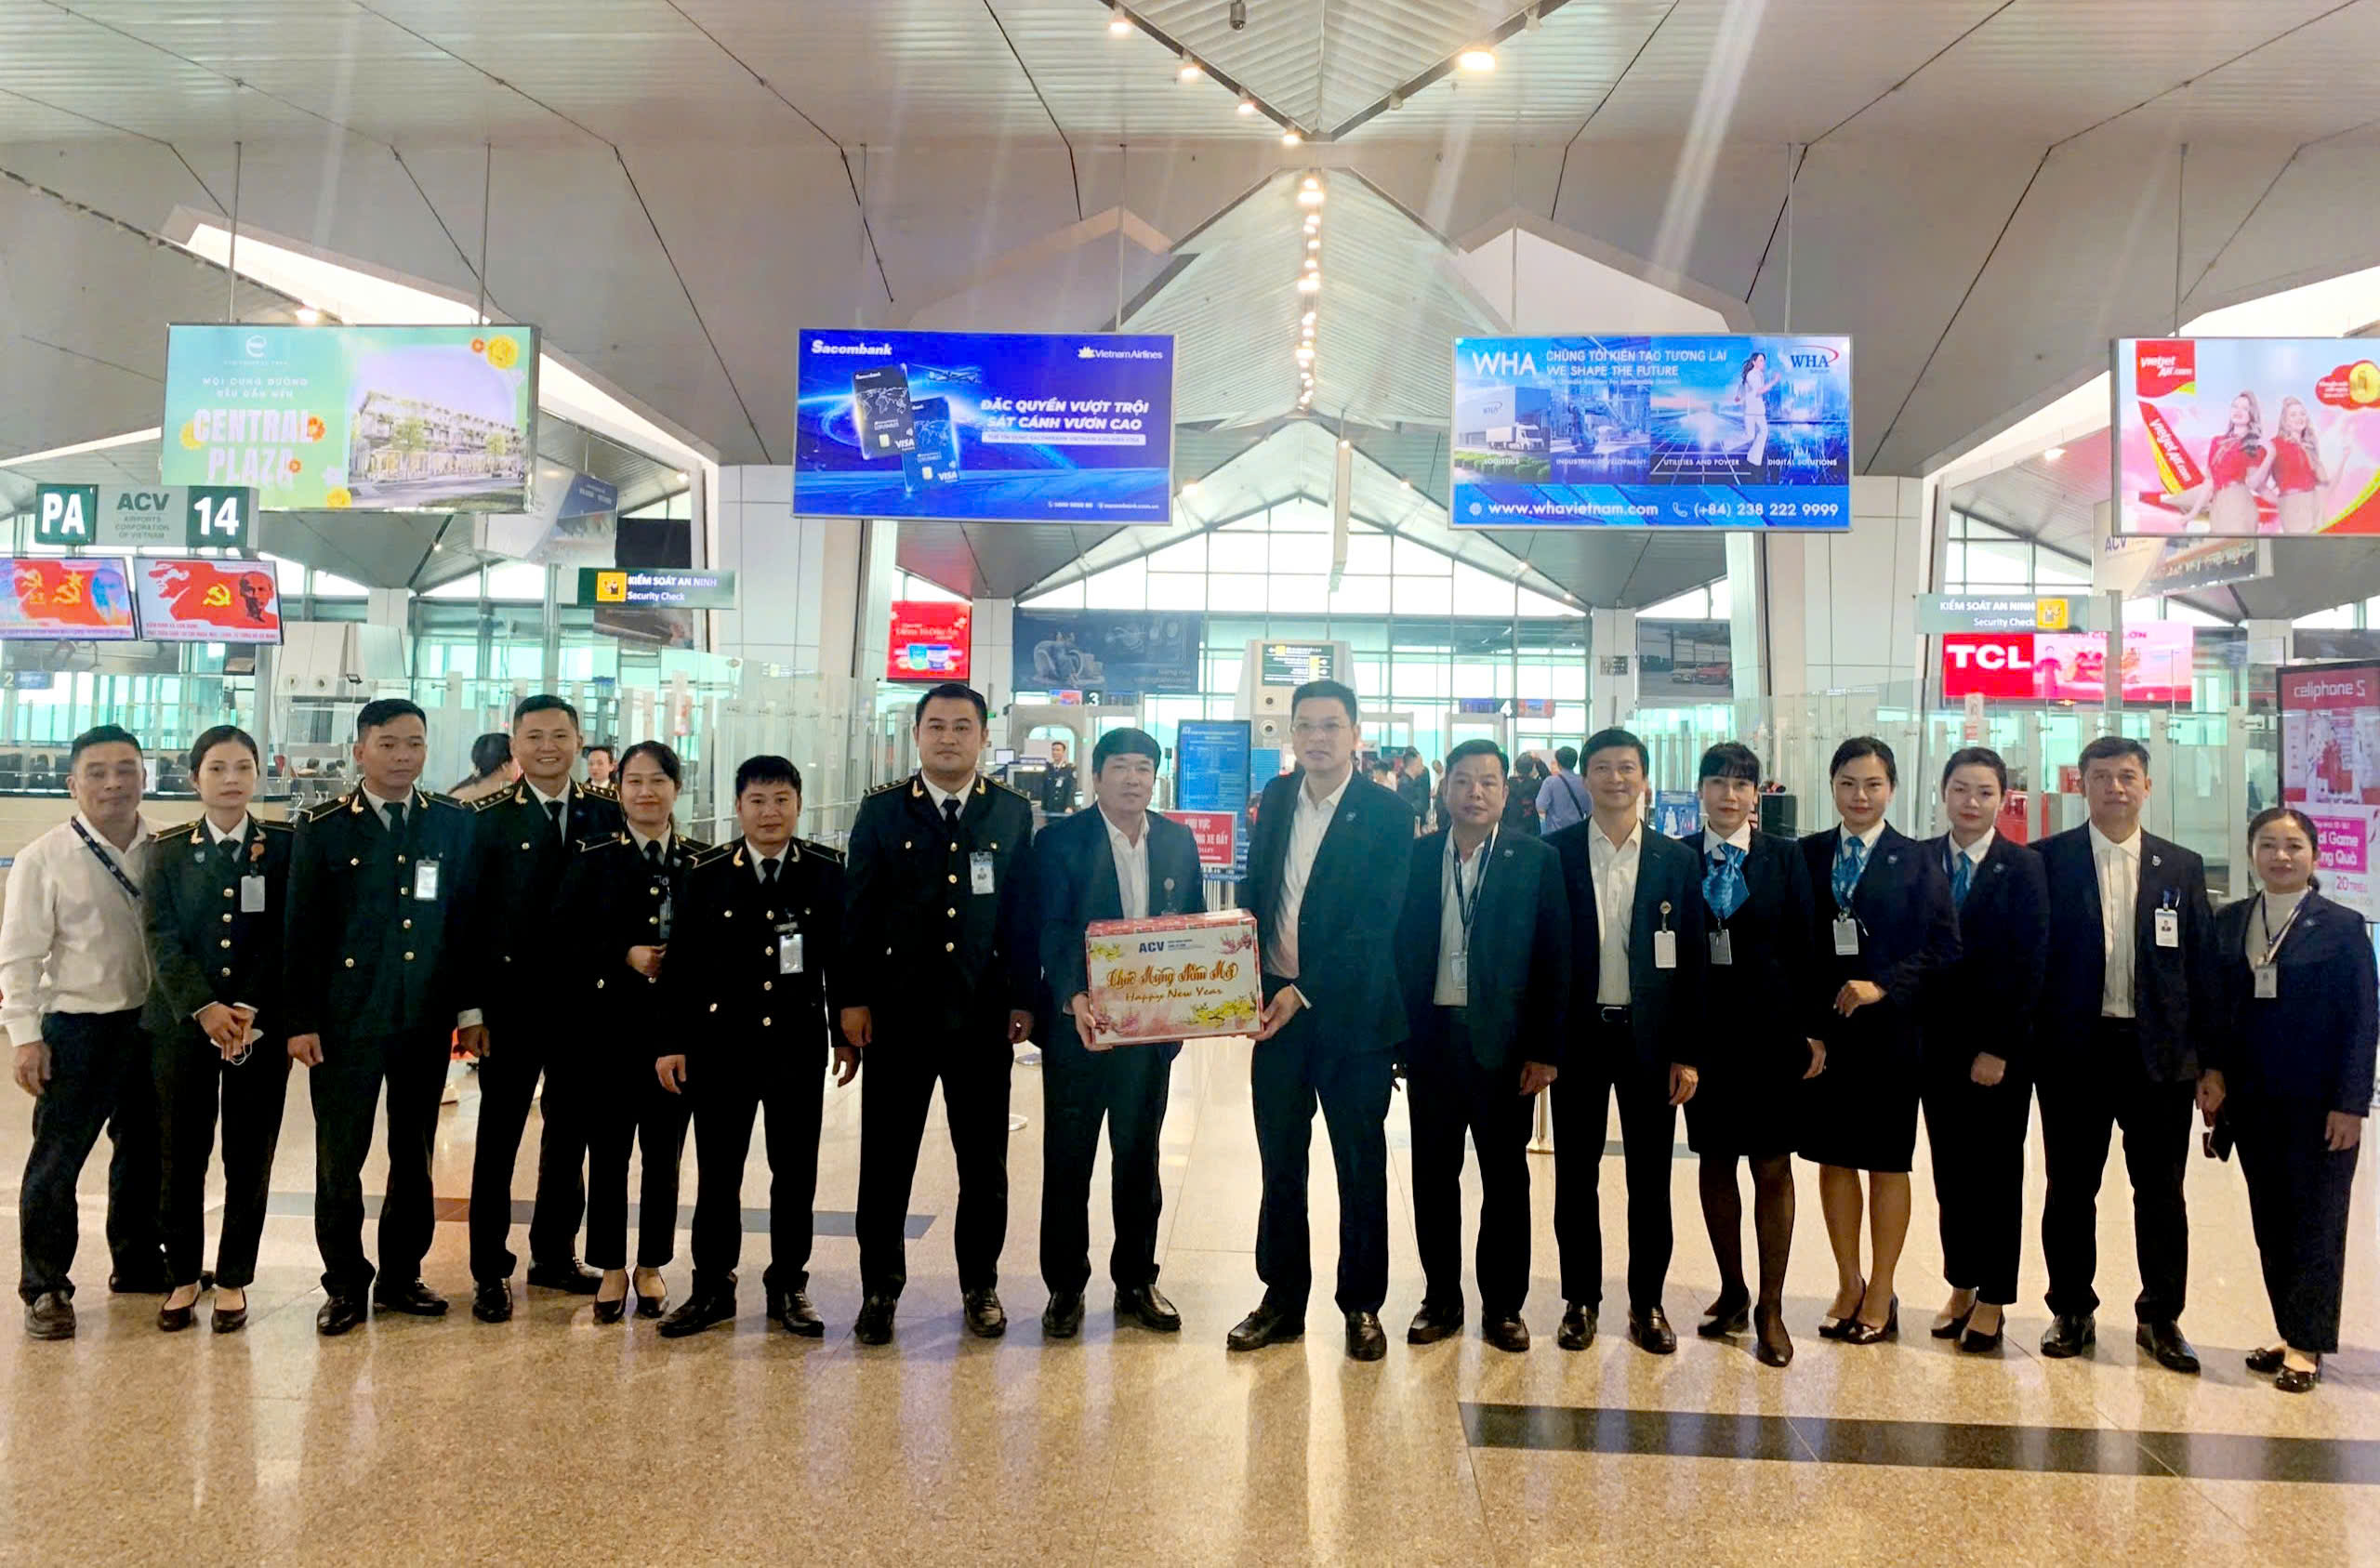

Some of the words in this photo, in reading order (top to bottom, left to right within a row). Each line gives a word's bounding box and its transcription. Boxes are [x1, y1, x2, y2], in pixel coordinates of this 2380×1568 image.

[811, 339, 892, 355] Sacombank
[1095, 349, 1130, 359] Vietnam
[1130, 349, 1163, 360] Airlines
[1473, 351, 1537, 376] WHA
[1546, 349, 1585, 362] CHÚNG
[1639, 350, 1661, 364] TẠO
[1666, 349, 1705, 362] TƯƠNG
[1709, 351, 1726, 362] LAI
[1791, 354, 1829, 368] WHA
[1546, 365, 1567, 376] WE
[1570, 365, 1606, 376] SHAPE
[1611, 365, 1633, 376] THE
[1636, 365, 1678, 376] FUTURE
[1070, 400, 1111, 415] VƯỢT
[1114, 400, 1149, 415] TRỘI
[193, 408, 313, 442] CENTRAL
[987, 415, 1016, 428] SÁT
[1019, 415, 1061, 428] CÁNH
[1110, 418, 1143, 430] CAO
[894, 439, 915, 448] VISA
[207, 447, 295, 489] PLAZA
[1797, 458, 1837, 467] SOLUTIONS
[937, 470, 958, 481] VISA
[116, 493, 169, 510] ACV
[1488, 499, 1659, 517] www.whavietnam.com
[41, 493, 86, 535] PA
[193, 496, 239, 536] 14
[1694, 502, 1732, 518] (+84)
[1737, 503, 1765, 517] 238
[1769, 503, 1797, 517] 222
[1802, 503, 1839, 517] 9999
[2105, 535, 2127, 552] ACV
[653, 574, 677, 586] SOÁT
[678, 576, 692, 586] AN
[693, 577, 717, 587] NINH
[628, 591, 659, 601] Security
[661, 591, 684, 600] Check
[1966, 600, 1991, 611] SOÁT
[1993, 601, 2008, 611] AN
[2009, 601, 2036, 611] NINH
[1973, 617, 2008, 627] Security
[2009, 617, 2035, 626] Check
[1946, 644, 2031, 669] TCL
[1087, 692, 1100, 706] 3
[1500, 699, 1513, 717] 4
[2328, 832, 2359, 847] Game
[2336, 876, 2349, 890] 20
[1139, 941, 1165, 953] ACV
[1126, 991, 1164, 1004] Happy
[1167, 989, 1192, 999] New
[1196, 986, 1223, 996] Year
